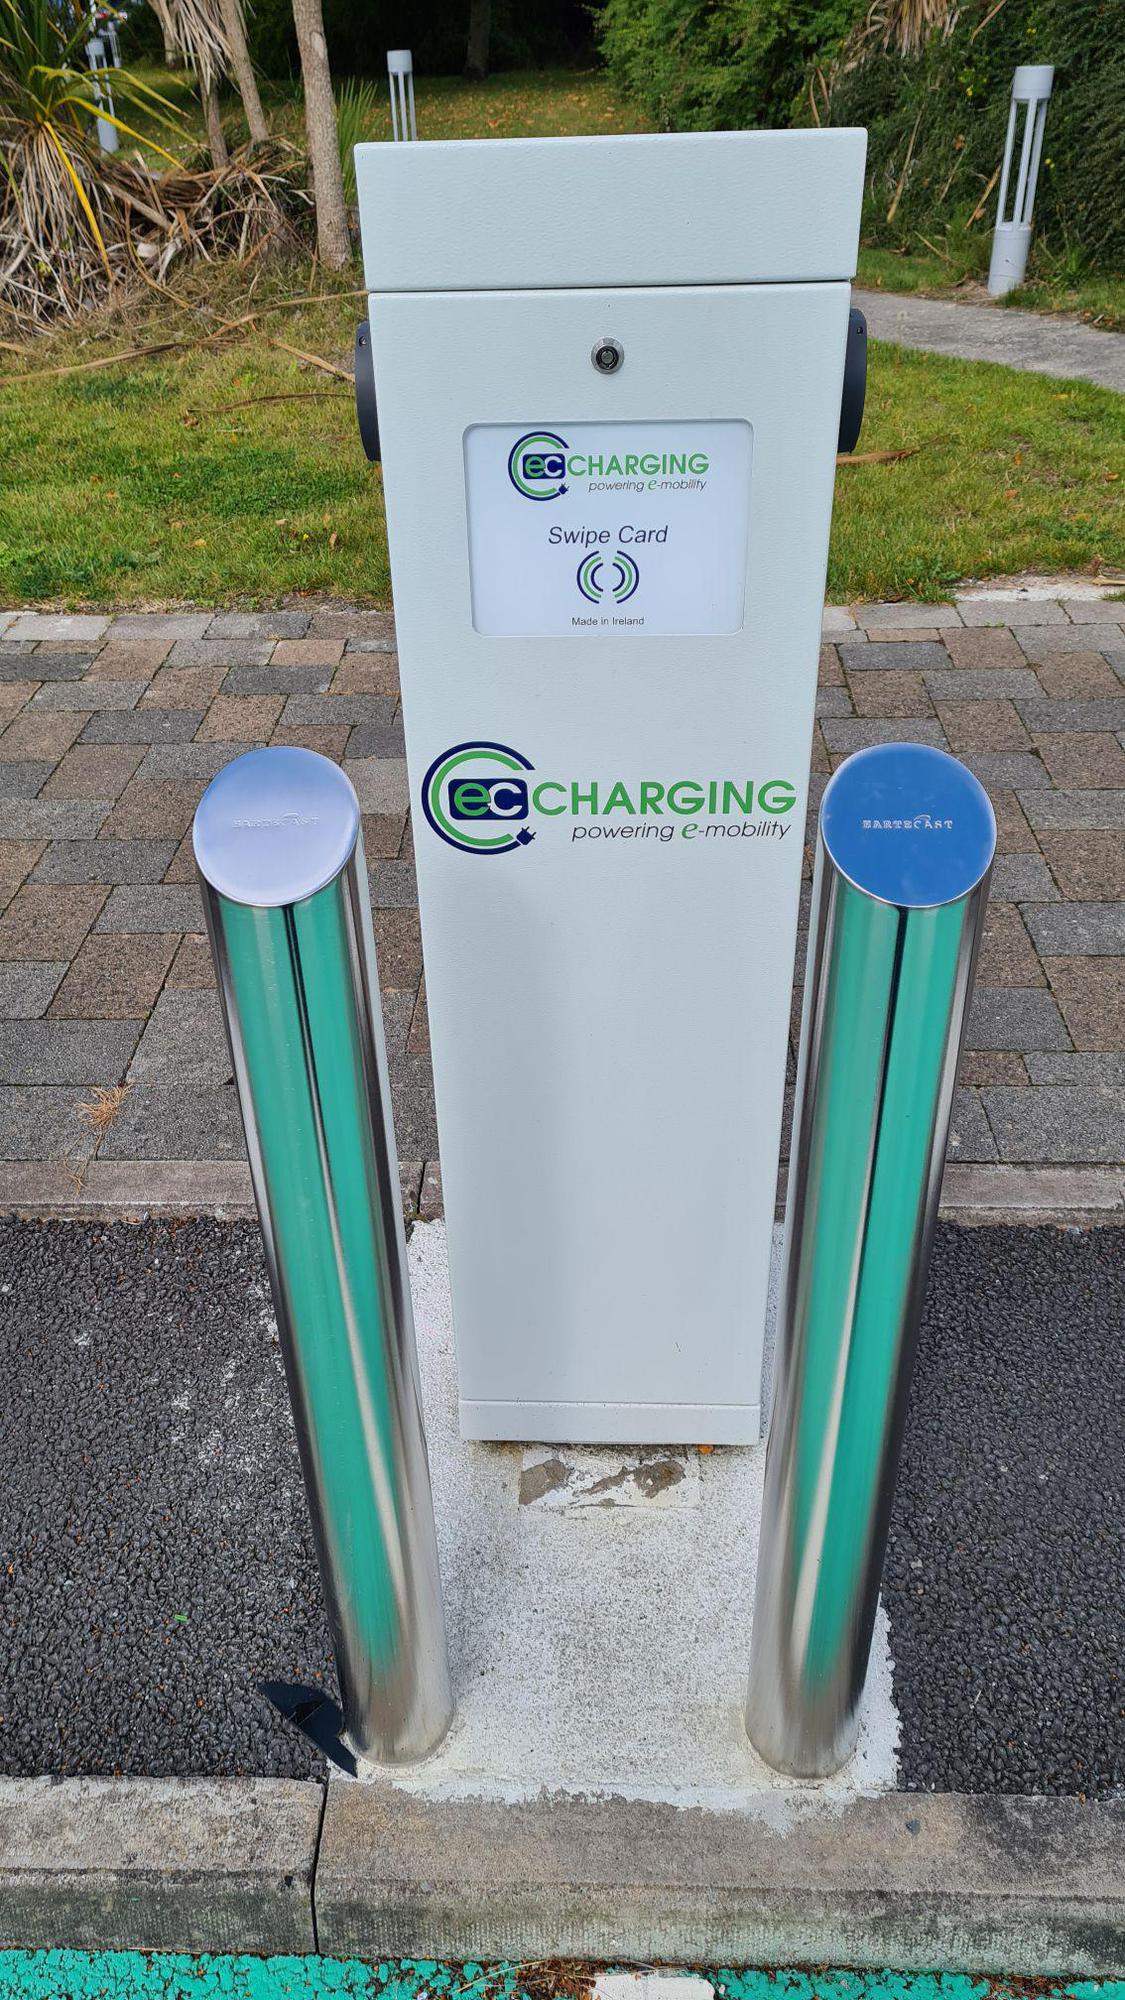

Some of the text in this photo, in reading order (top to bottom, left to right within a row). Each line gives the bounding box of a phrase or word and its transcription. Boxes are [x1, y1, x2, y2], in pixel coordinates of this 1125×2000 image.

[567, 453, 710, 477] CHARGING
[588, 479, 707, 493] powering e-mobility
[548, 525, 669, 548] Swipe Card
[571, 616, 645, 626] Made in Ireland
[532, 780, 797, 817] CHARGING
[572, 820, 792, 843] powering e-mobility
